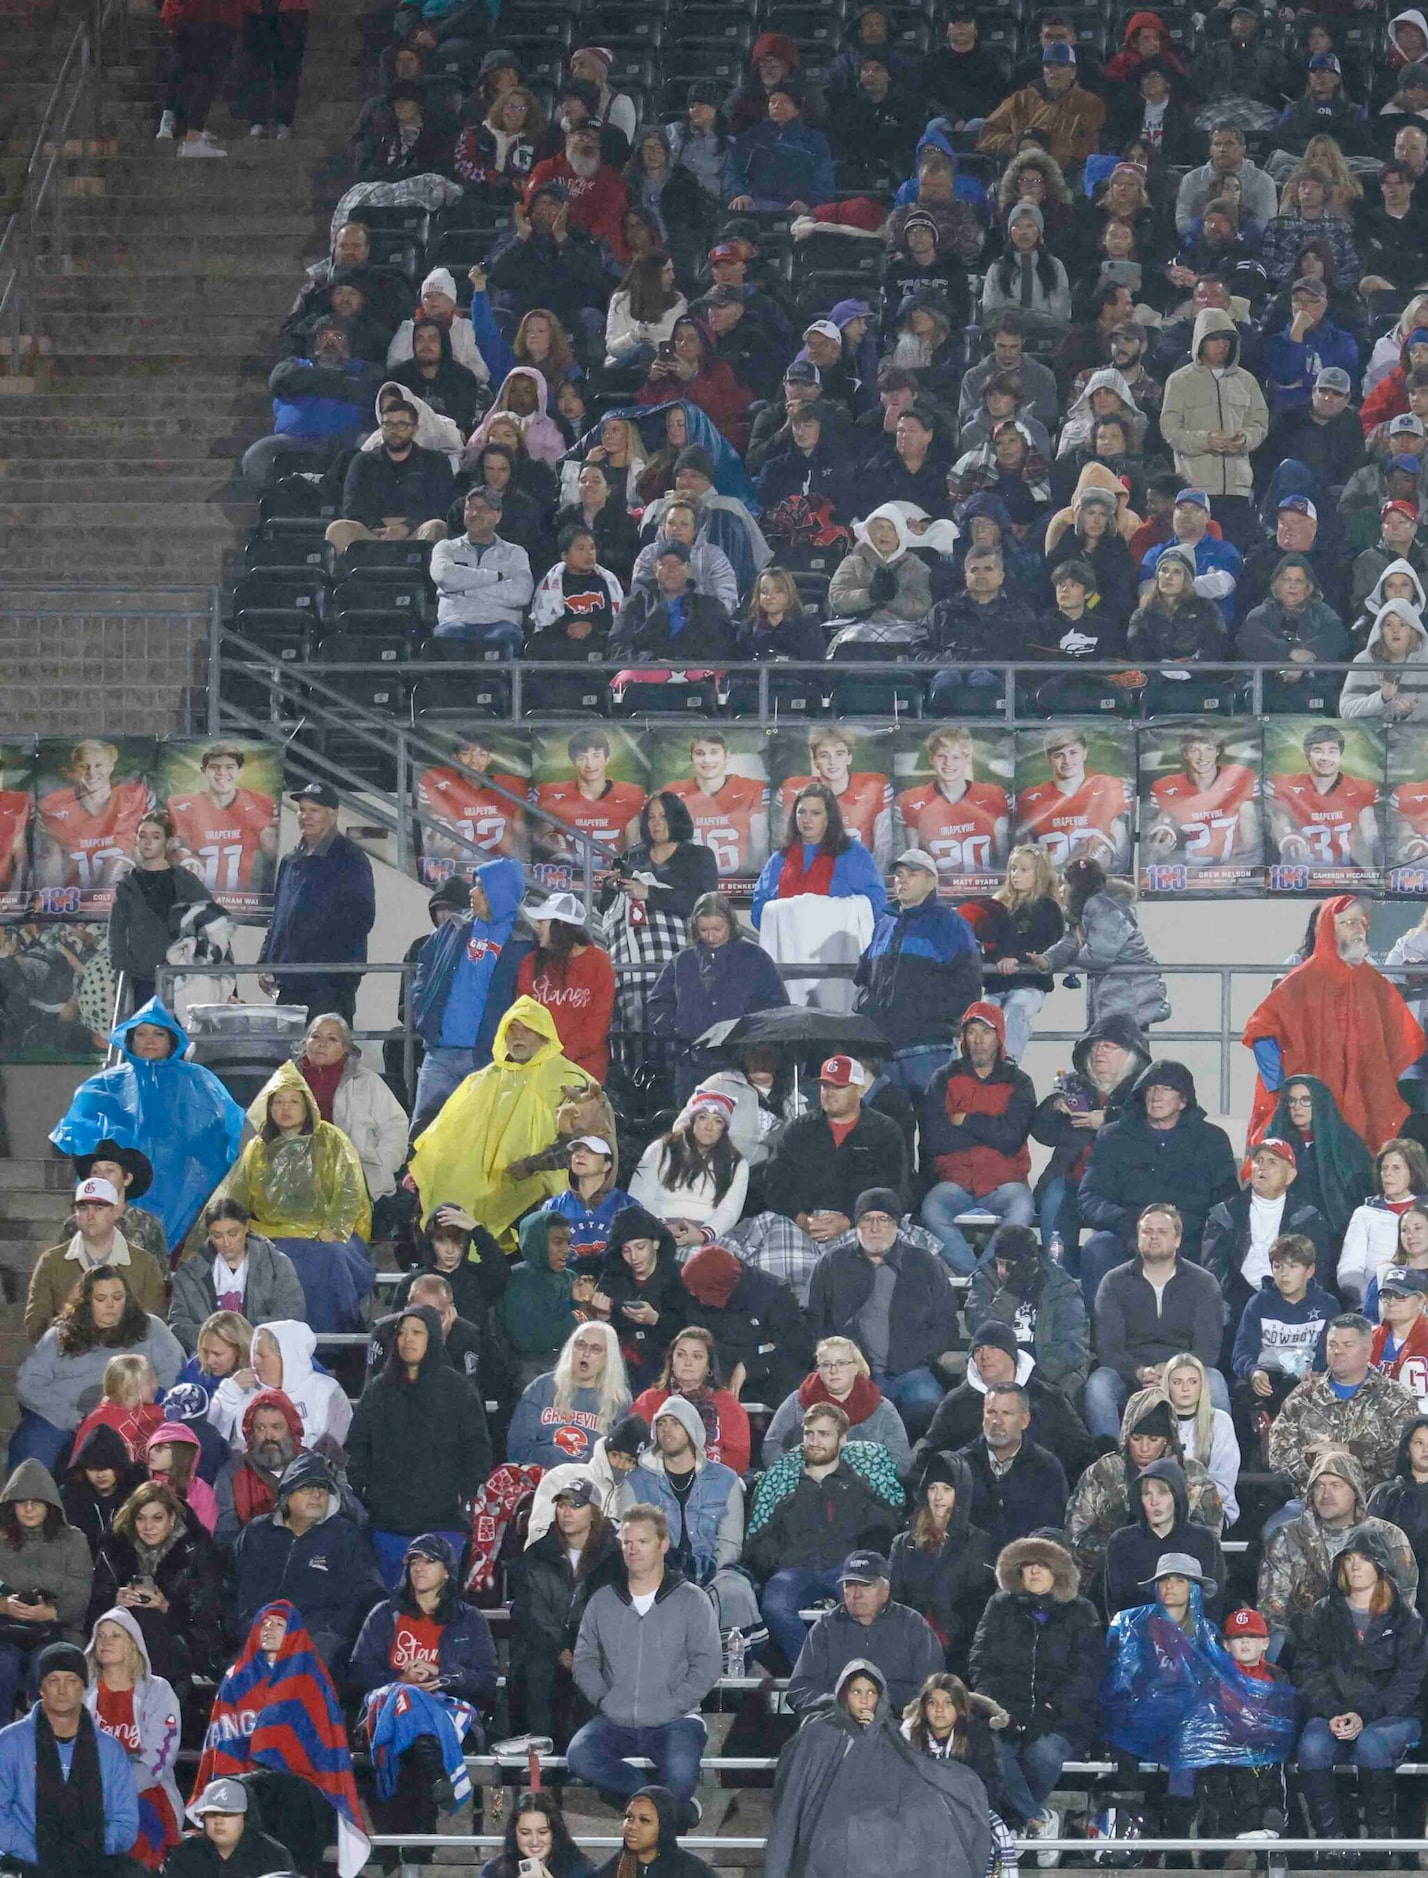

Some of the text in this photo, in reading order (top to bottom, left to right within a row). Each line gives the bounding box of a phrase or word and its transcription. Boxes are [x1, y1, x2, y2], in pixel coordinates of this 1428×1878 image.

[696, 816, 730, 826] GRAPEVINE
[1052, 815, 1089, 827] GRAPEVINE
[1192, 809, 1224, 821] GRAPEVINE
[1311, 810, 1344, 821] GRAPEVINE
[576, 818, 608, 828] GRAPEVINE
[941, 823, 975, 835] GRAPEVINE
[1180, 815, 1239, 865] 27
[1303, 823, 1351, 864] 31
[929, 835, 992, 874] 20
[199, 845, 242, 889] 11
[1312, 872, 1345, 880] CAMERON
[530, 975, 593, 1009] Stangs
